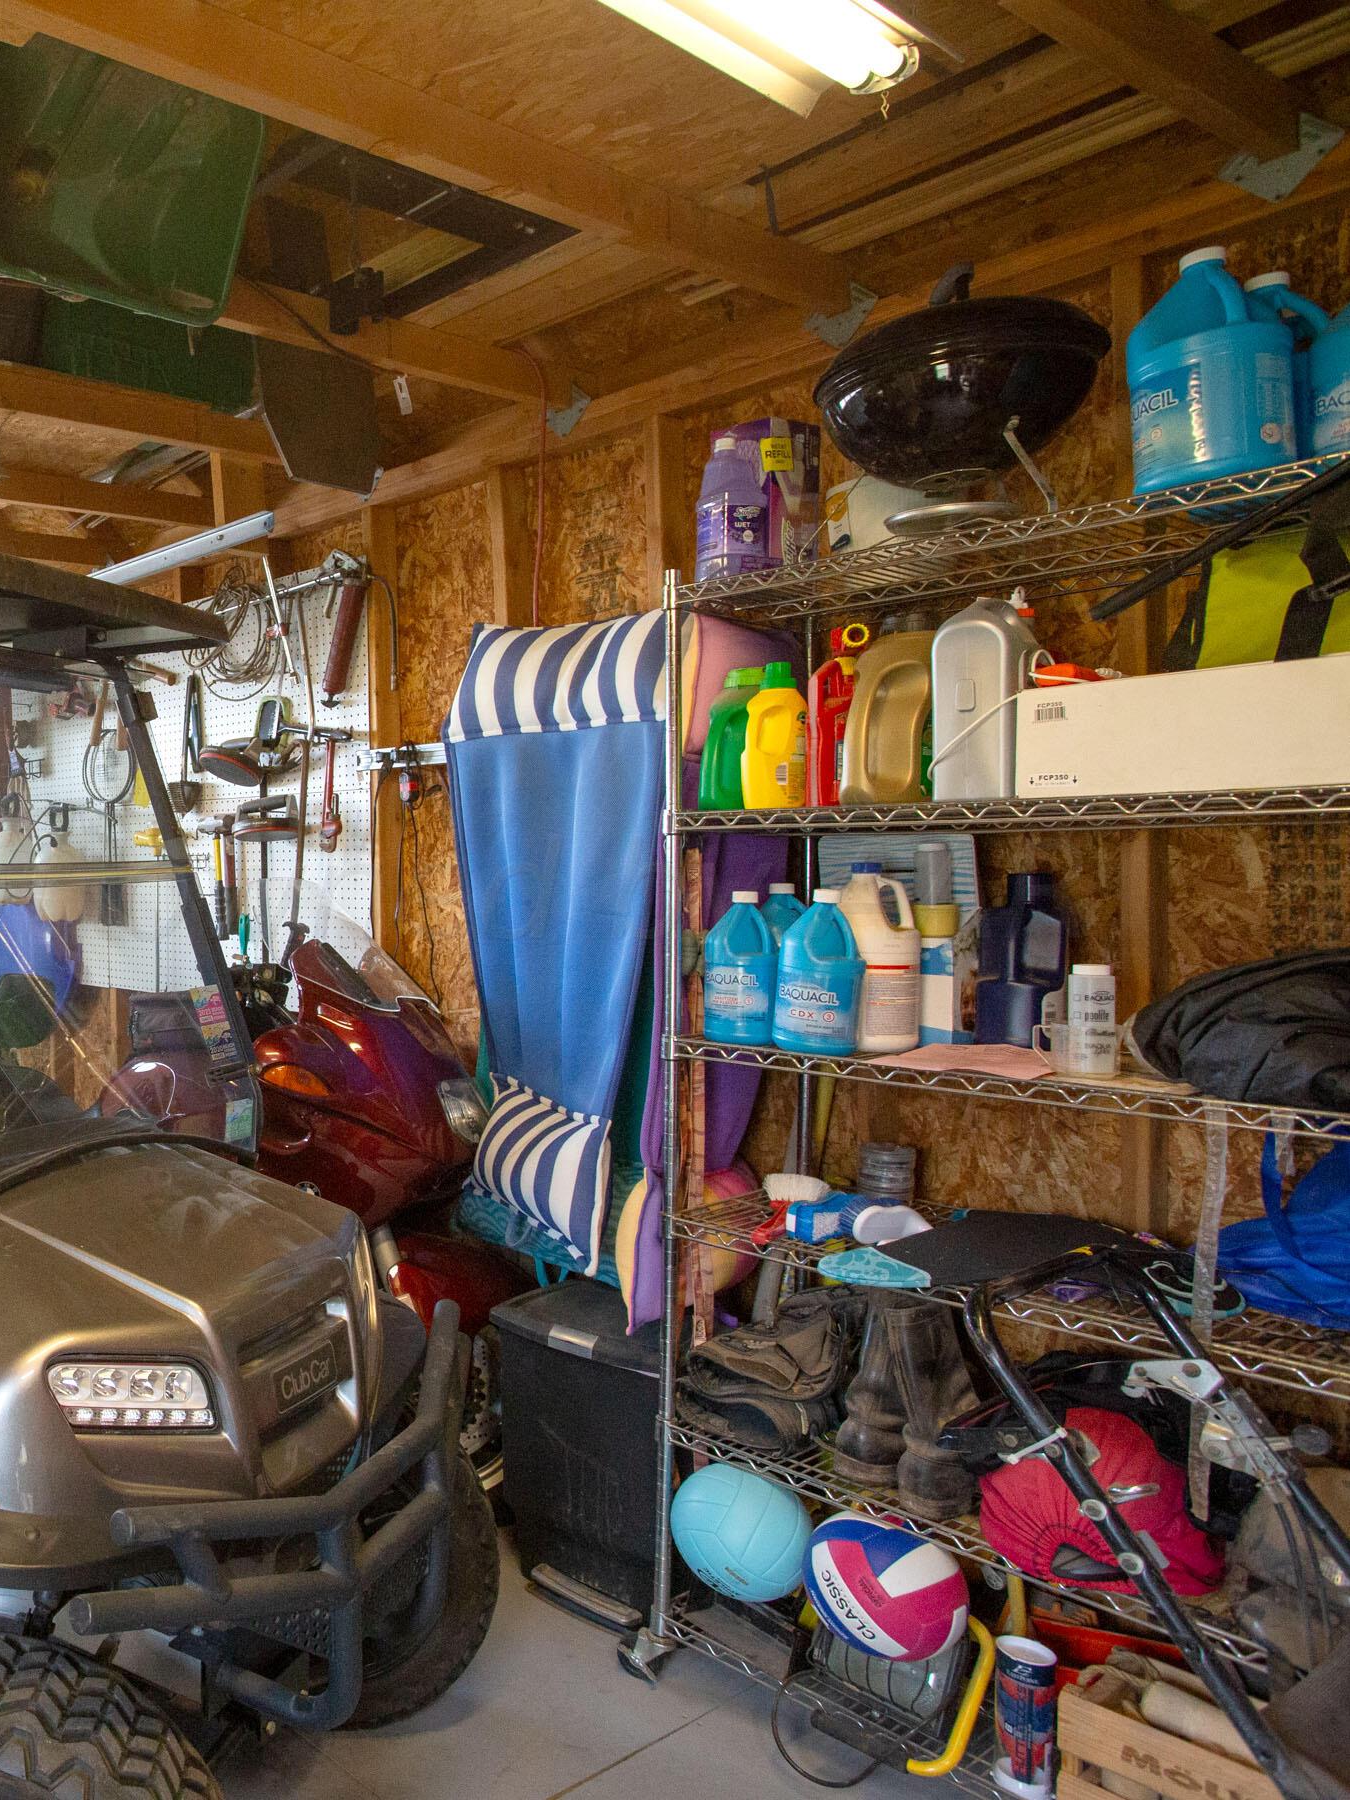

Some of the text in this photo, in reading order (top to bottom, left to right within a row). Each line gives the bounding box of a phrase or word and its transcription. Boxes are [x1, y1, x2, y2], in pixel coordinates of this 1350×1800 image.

[706, 973, 758, 986] BAQUACIL
[779, 985, 838, 1005] BAQUACIL
[281, 1358, 330, 1399] Club Car
[821, 1570, 876, 1640] CLASSIC
